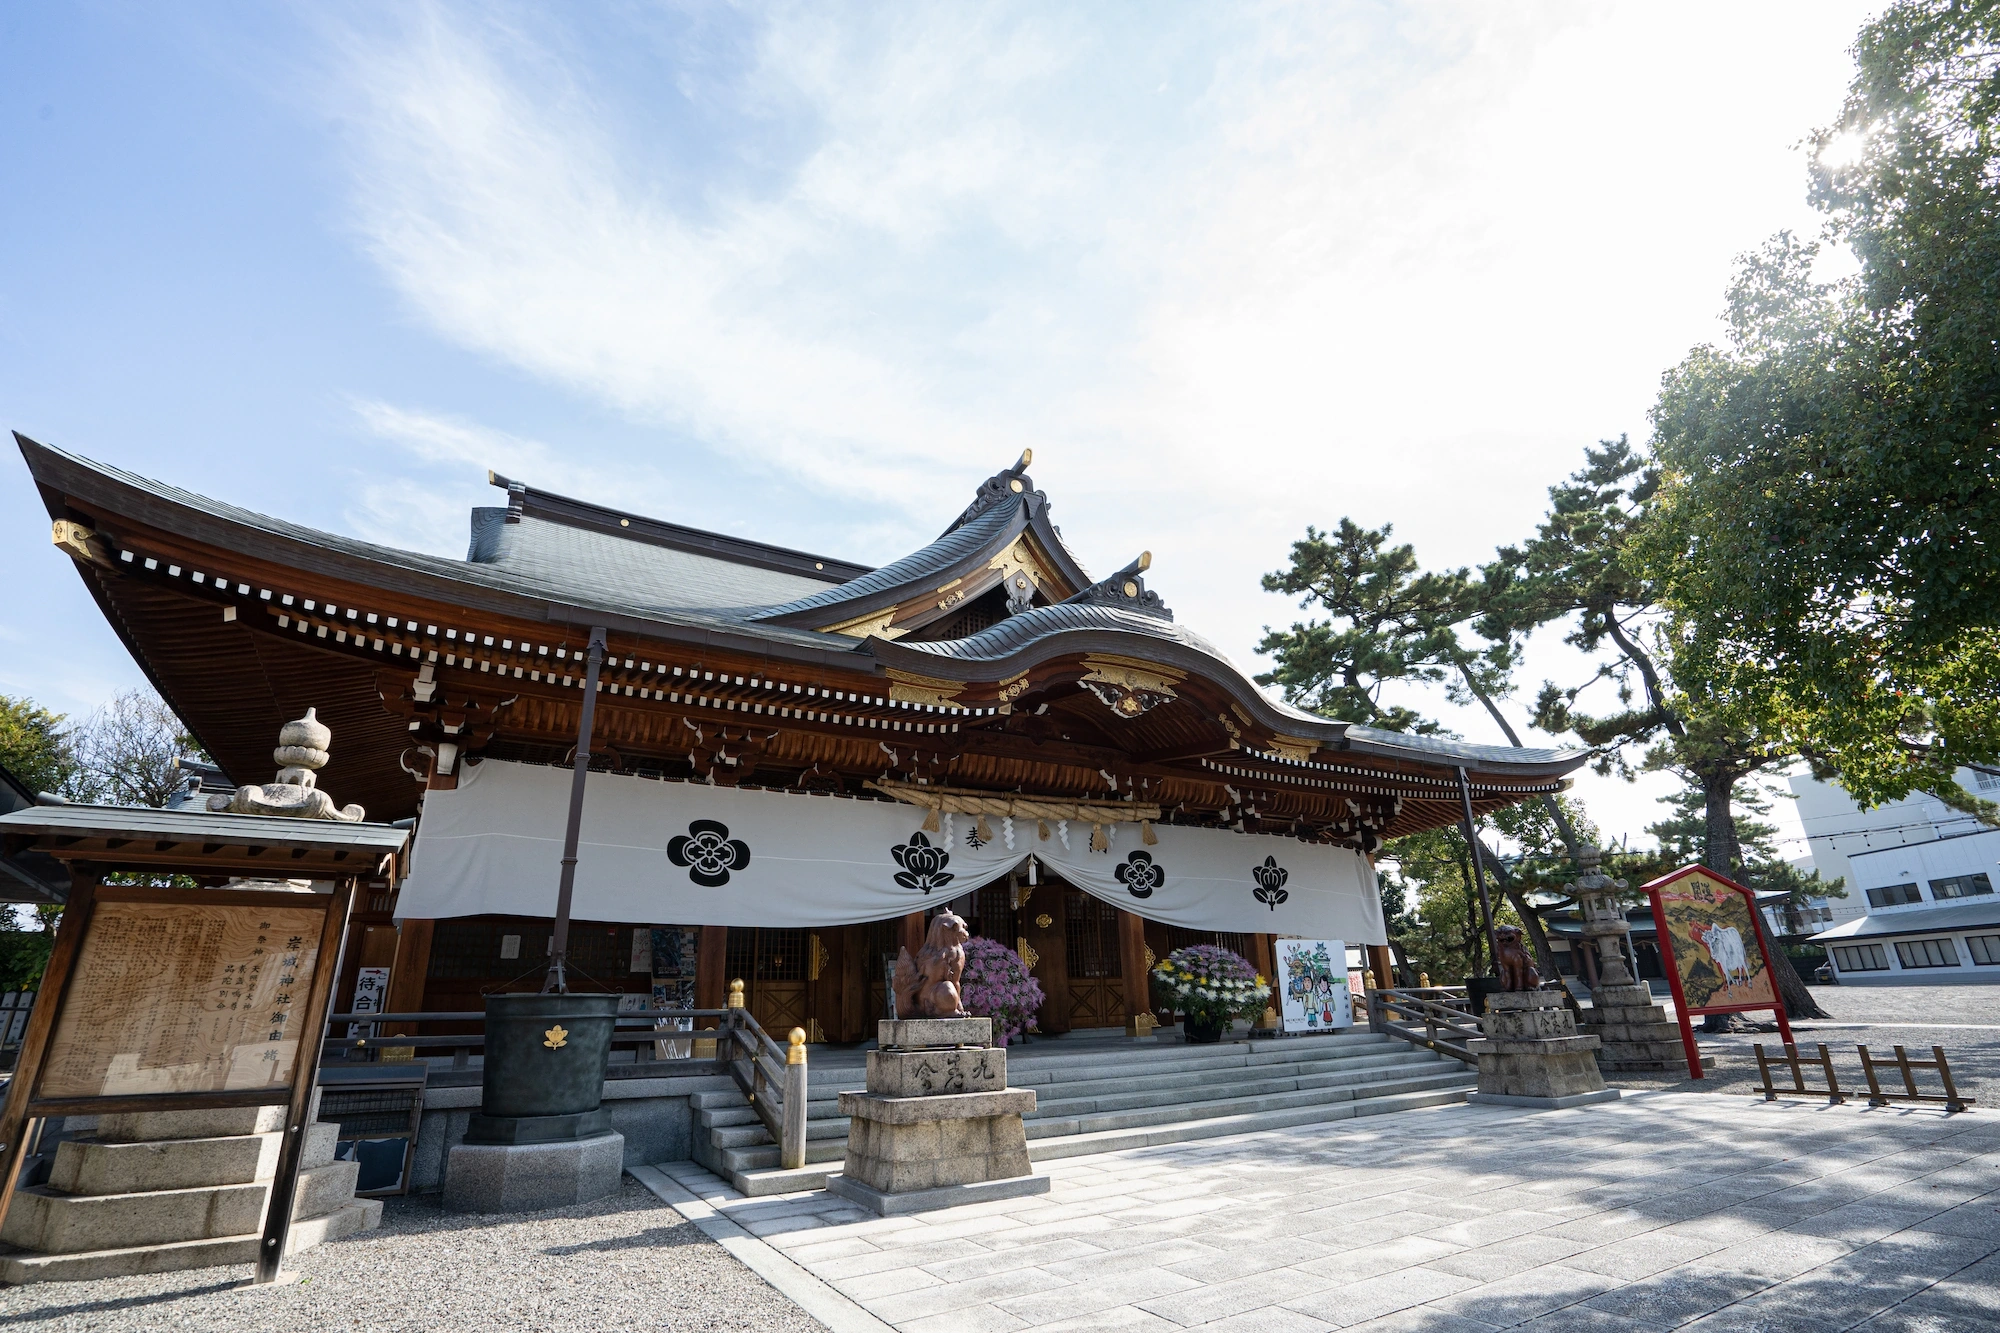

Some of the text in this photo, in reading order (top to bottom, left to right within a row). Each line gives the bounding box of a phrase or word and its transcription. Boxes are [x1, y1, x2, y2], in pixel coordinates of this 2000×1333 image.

[966, 826, 988, 851] 奉
[252, 921, 271, 957] 御祭神
[262, 936, 303, 1062] 岸城神社御由緒
